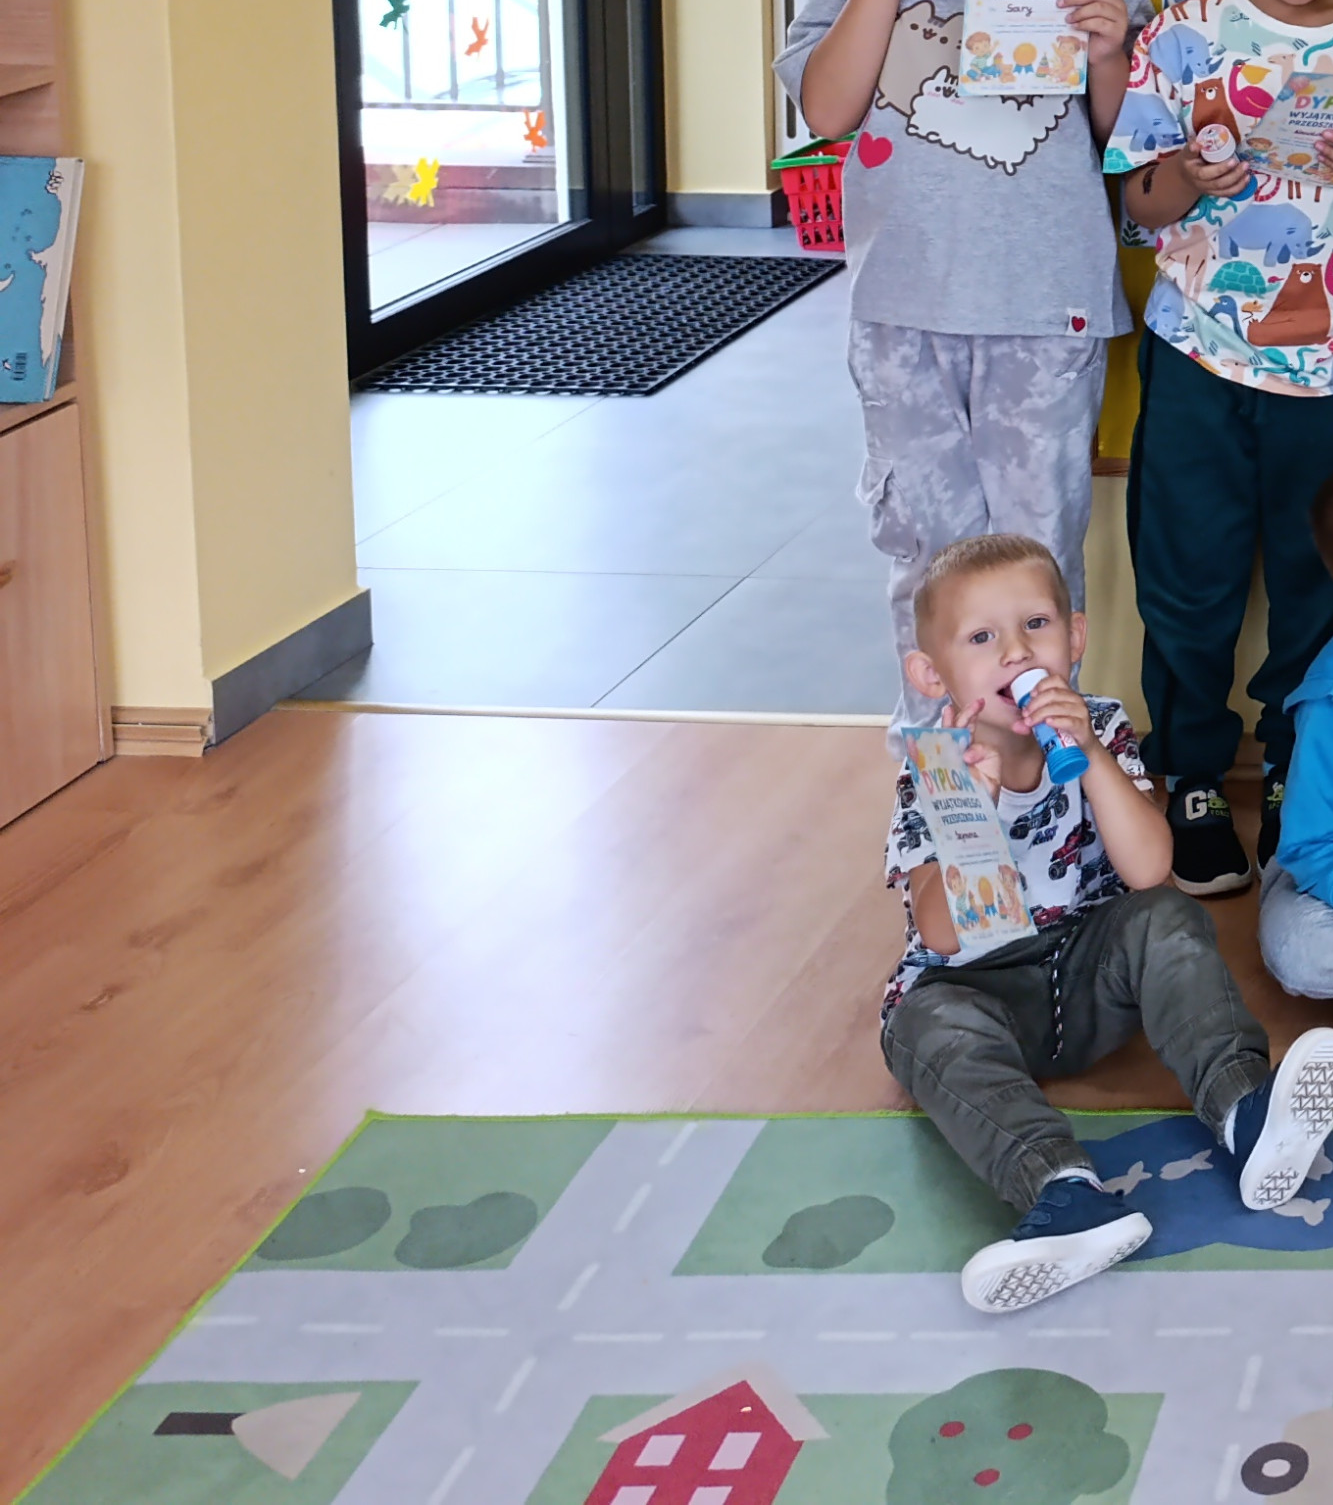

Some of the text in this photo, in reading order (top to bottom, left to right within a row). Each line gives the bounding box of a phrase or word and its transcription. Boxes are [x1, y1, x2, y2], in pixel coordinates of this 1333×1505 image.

[1006, 4, 1033, 17] Sary
[922, 767, 977, 795] DYPLOM
[932, 797, 983, 811] WYJĄTKOWEGO
